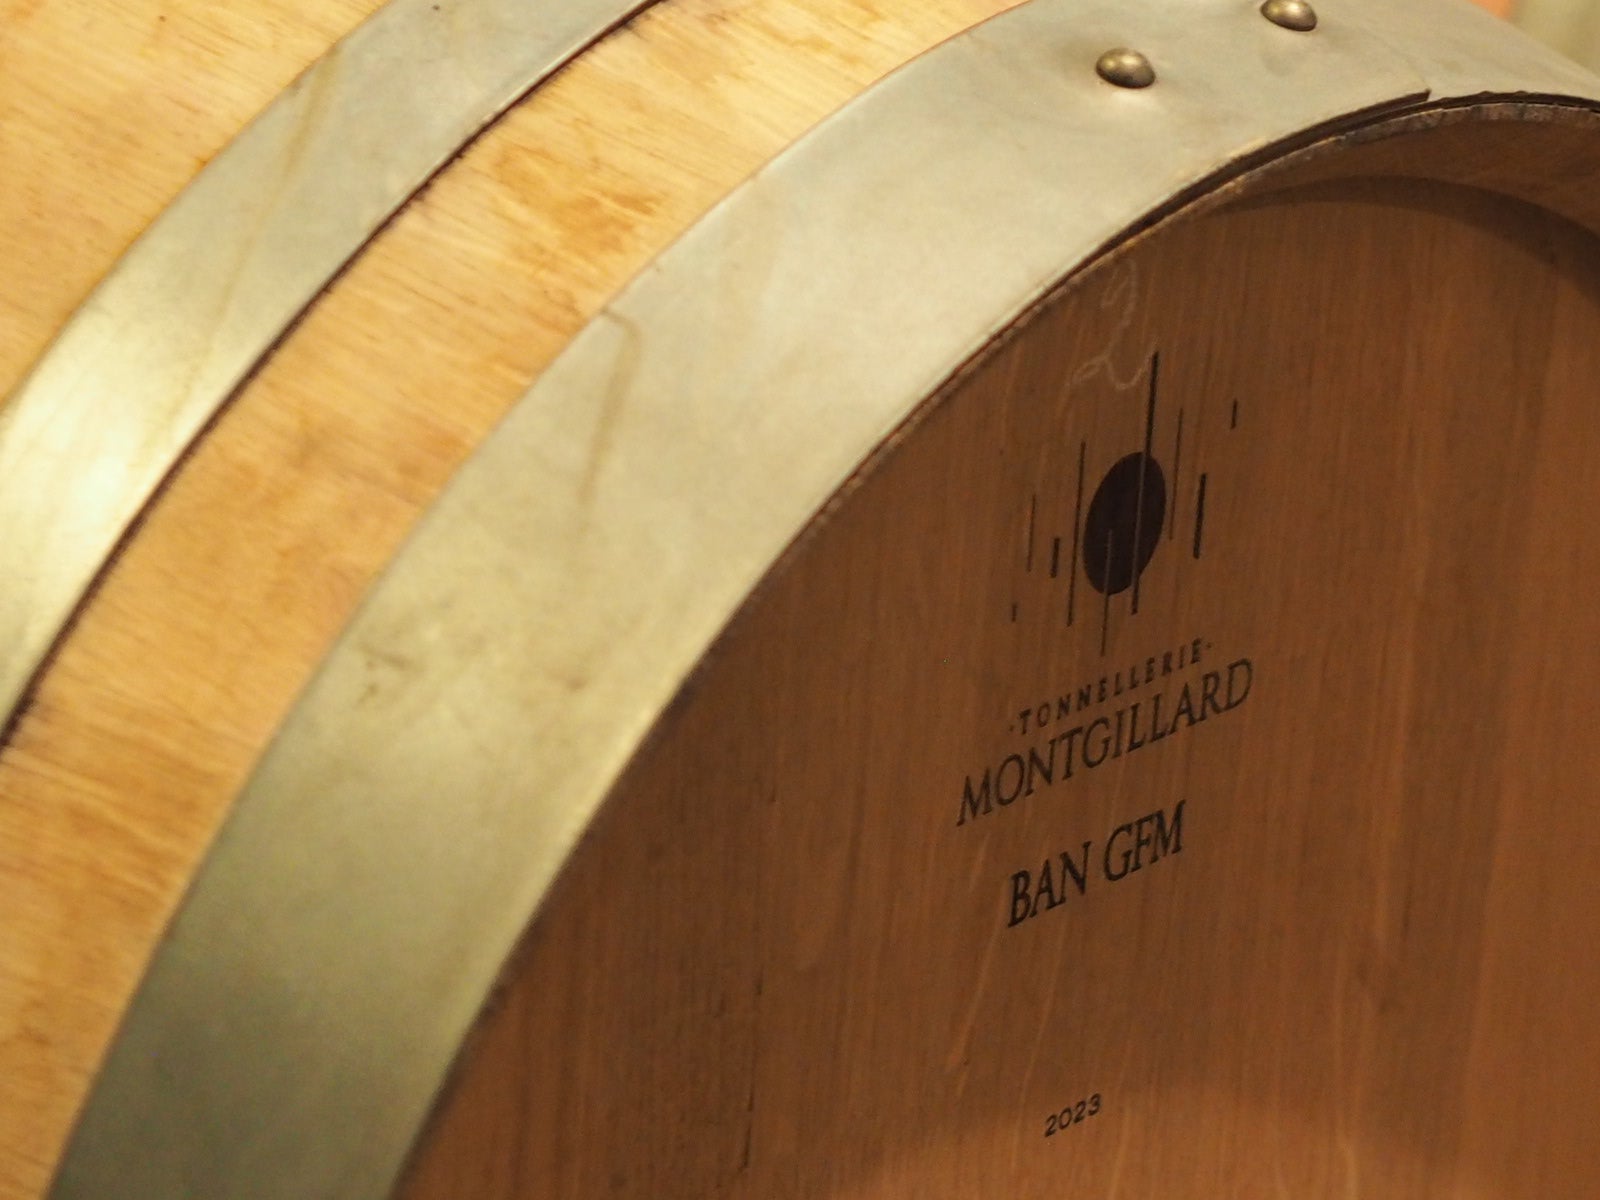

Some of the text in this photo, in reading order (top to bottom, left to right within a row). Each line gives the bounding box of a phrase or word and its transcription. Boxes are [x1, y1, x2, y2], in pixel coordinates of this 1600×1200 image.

[956, 657, 1254, 827] MONTGILLARD
[1007, 799, 1187, 928] BAN GFM
[1044, 1092, 1102, 1138] 2023
